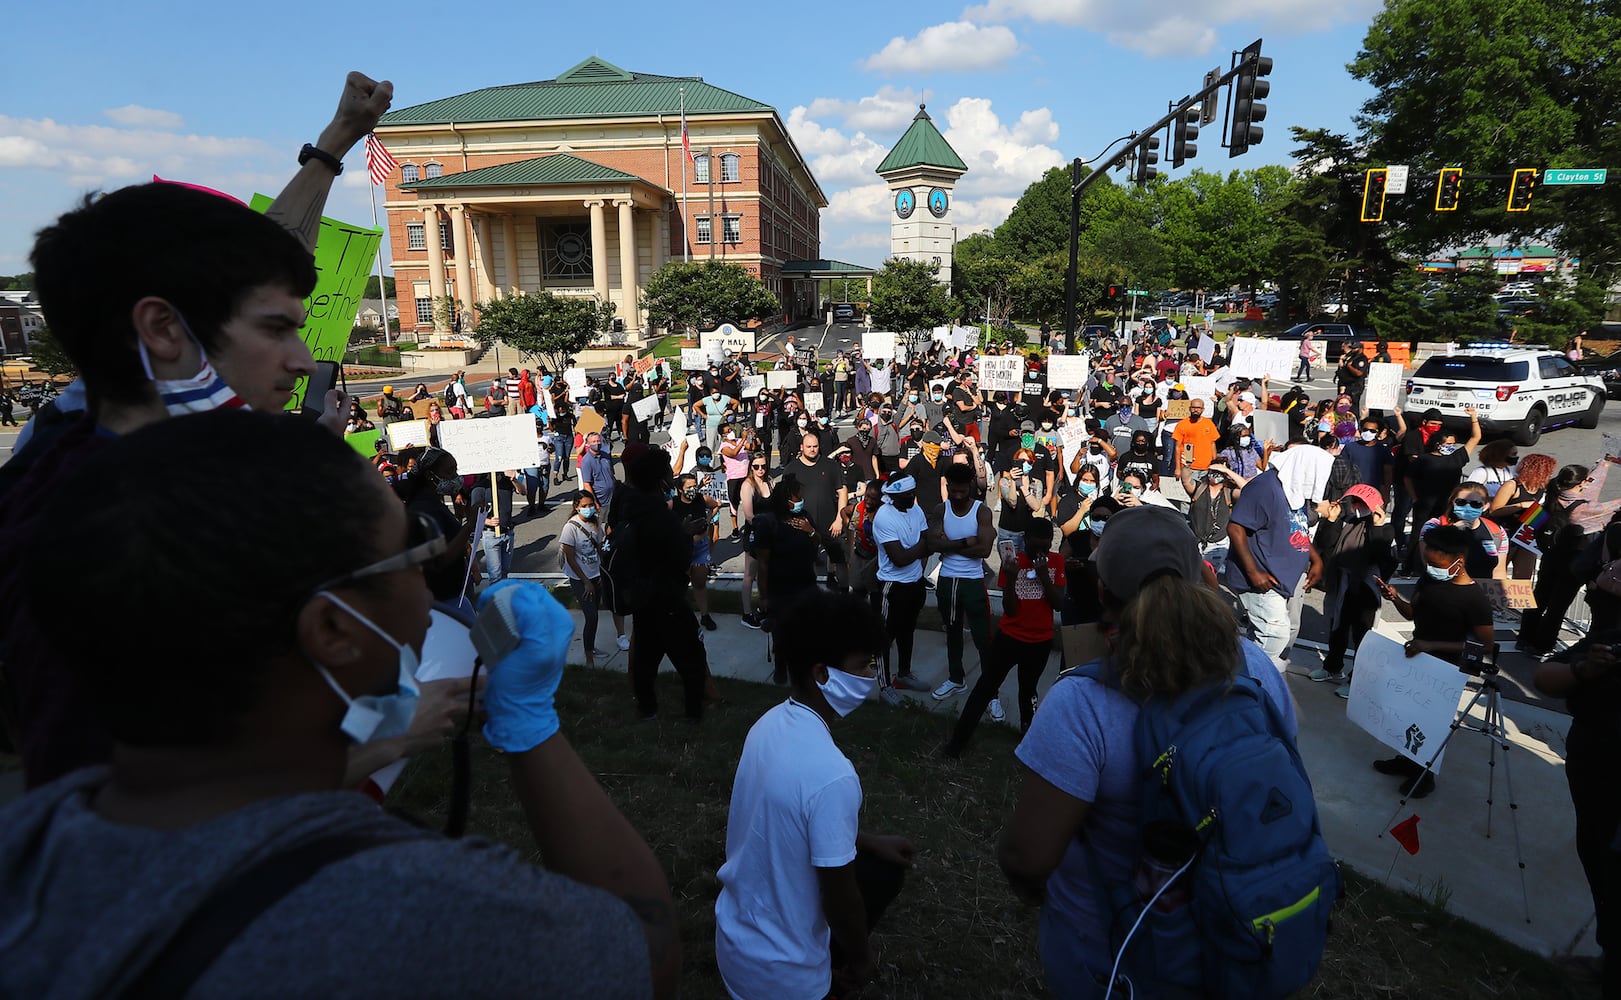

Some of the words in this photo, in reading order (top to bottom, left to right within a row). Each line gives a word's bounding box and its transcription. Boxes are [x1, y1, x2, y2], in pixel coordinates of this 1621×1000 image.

[1547, 173, 1553, 181] S
[1557, 173, 1589, 183] Clayton
[1594, 173, 1603, 181] St
[727, 338, 748, 347] HALL
[984, 360, 997, 369] HOW
[984, 370, 995, 379] LIFE
[1518, 394, 1534, 402] 911
[1547, 391, 1588, 405] POLICE
[1410, 398, 1441, 407] LILBURN
[1458, 402, 1491, 410] POLICE
[1551, 400, 1582, 410] LILBURN
[1501, 596, 1532, 608] PEACE
[1400, 664, 1461, 704] JUSTICE
[1386, 678, 1433, 710] PEACE
